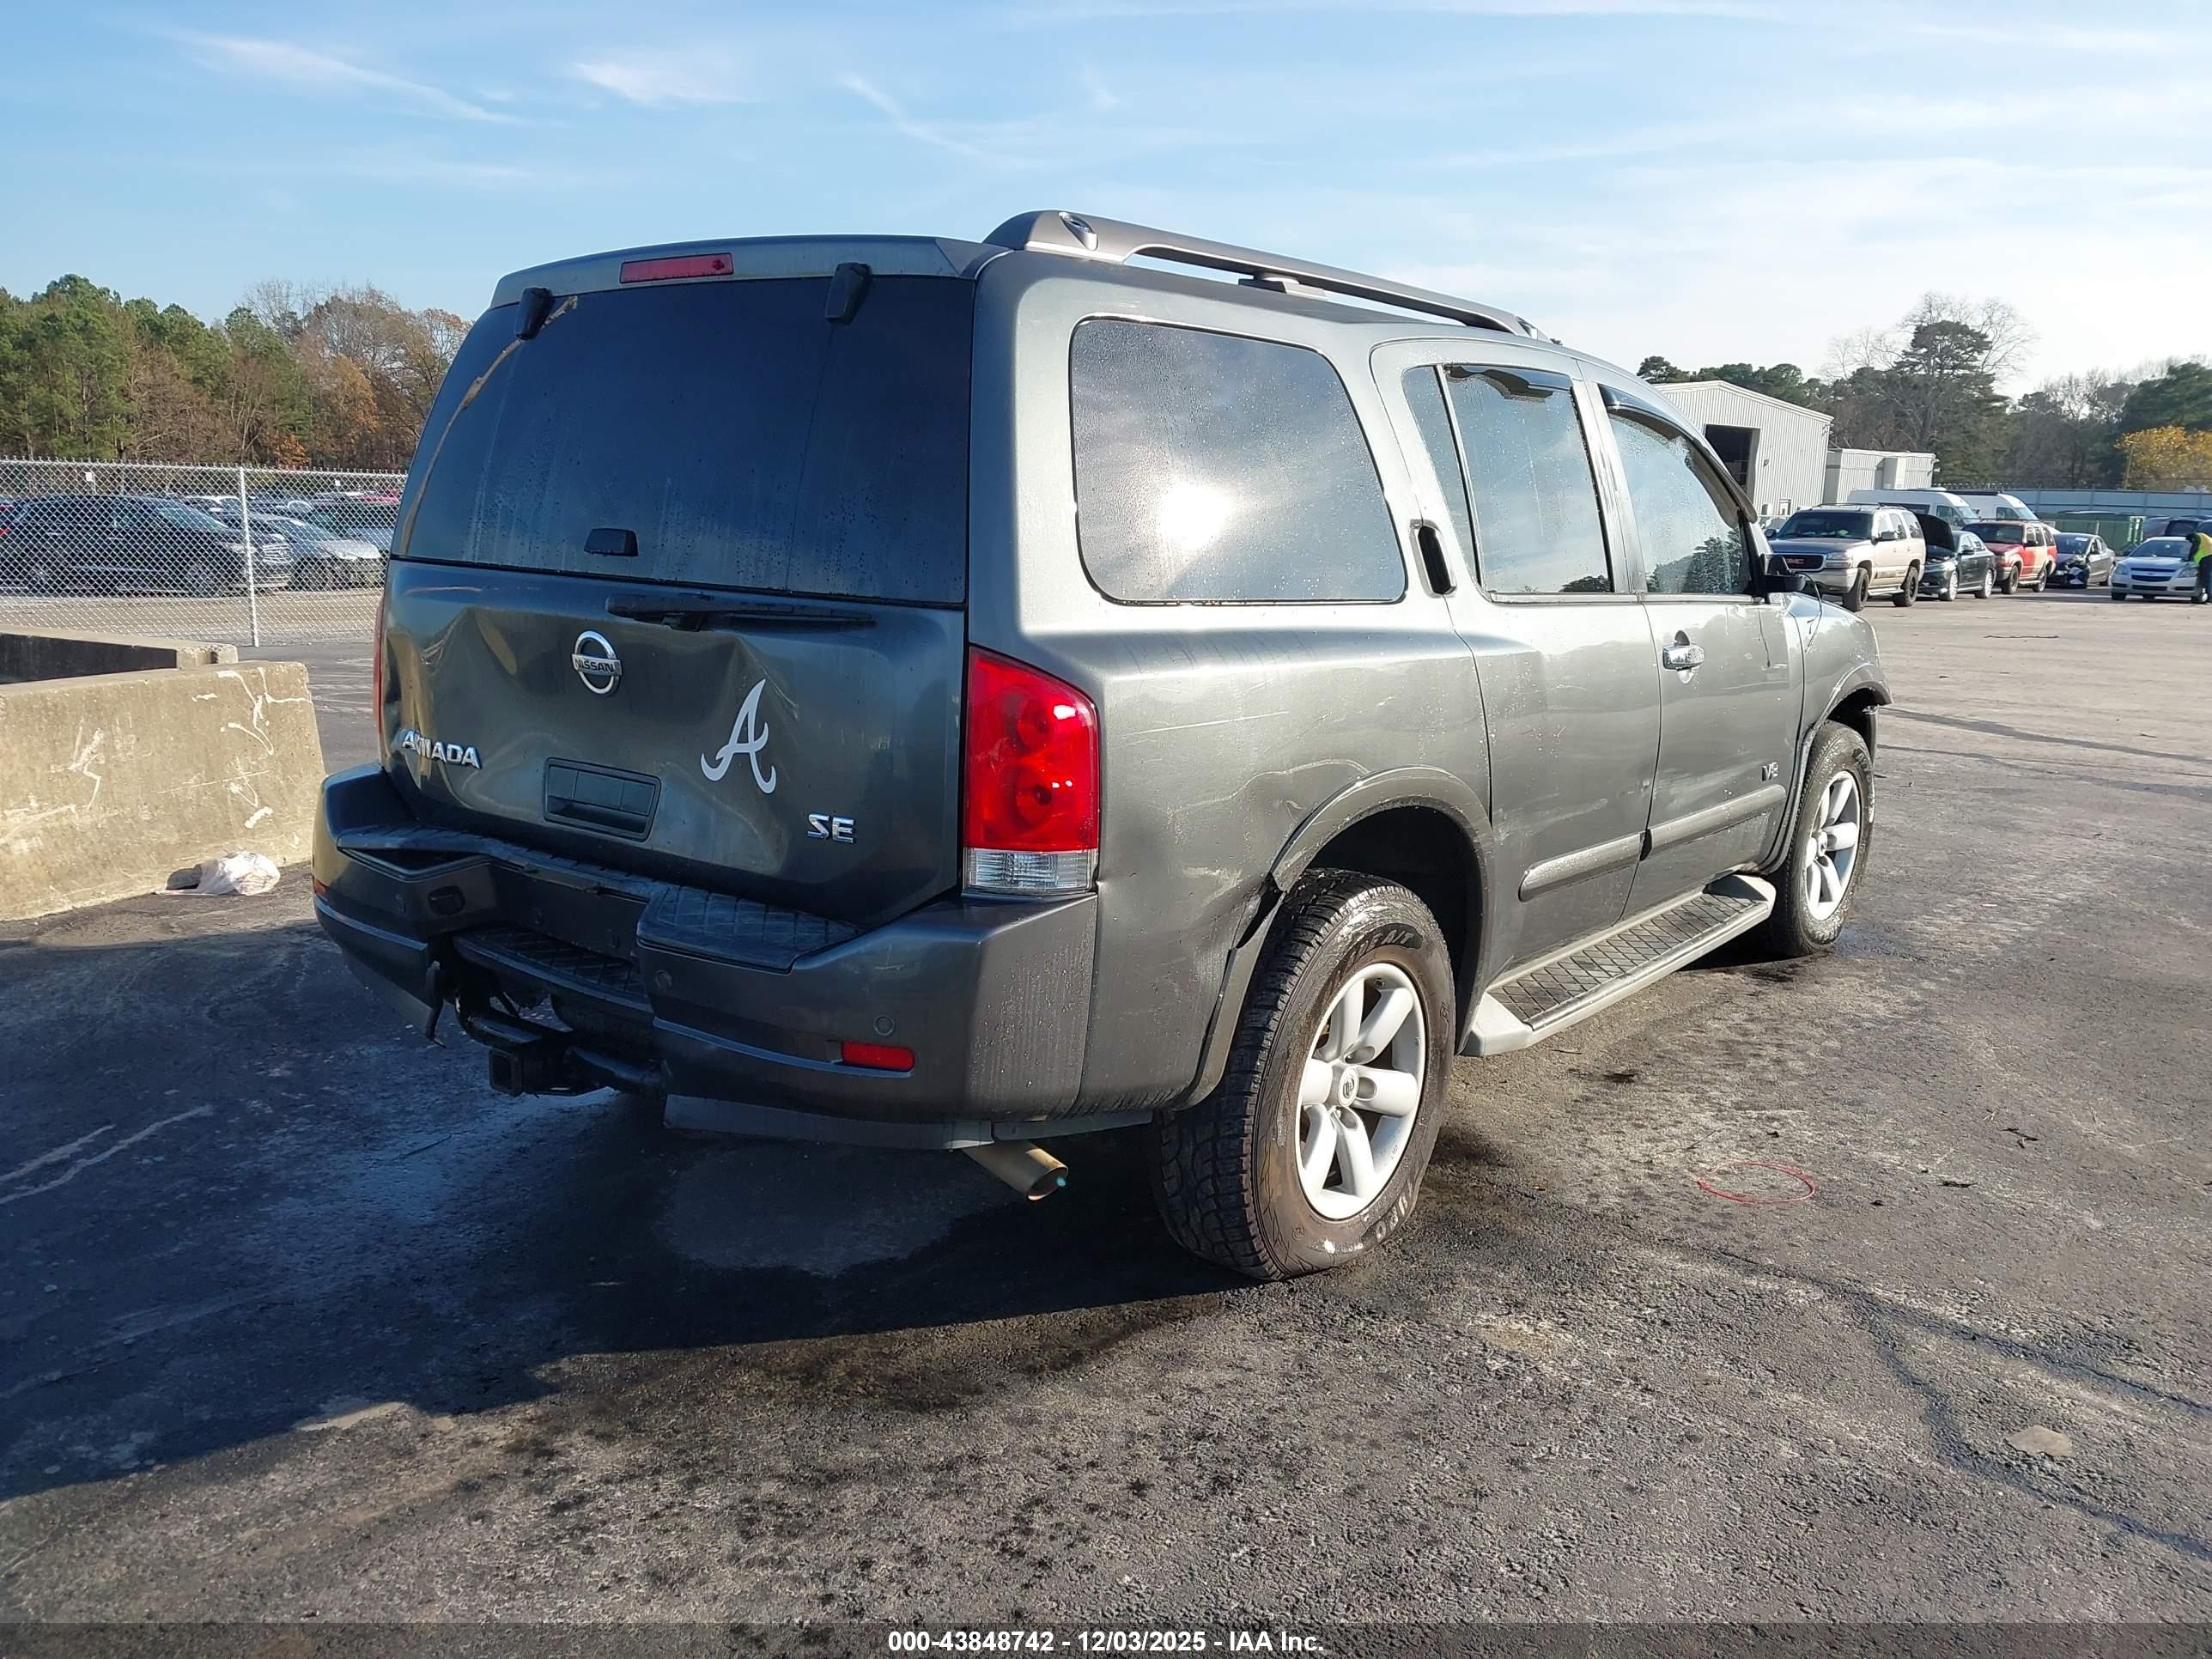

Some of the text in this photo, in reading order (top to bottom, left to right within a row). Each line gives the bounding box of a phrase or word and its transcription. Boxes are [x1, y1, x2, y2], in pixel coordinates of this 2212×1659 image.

[574, 658, 614, 672] NISSAN
[700, 678, 777, 795] A
[1761, 762, 1779, 781] V8
[807, 813, 854, 845] SE
